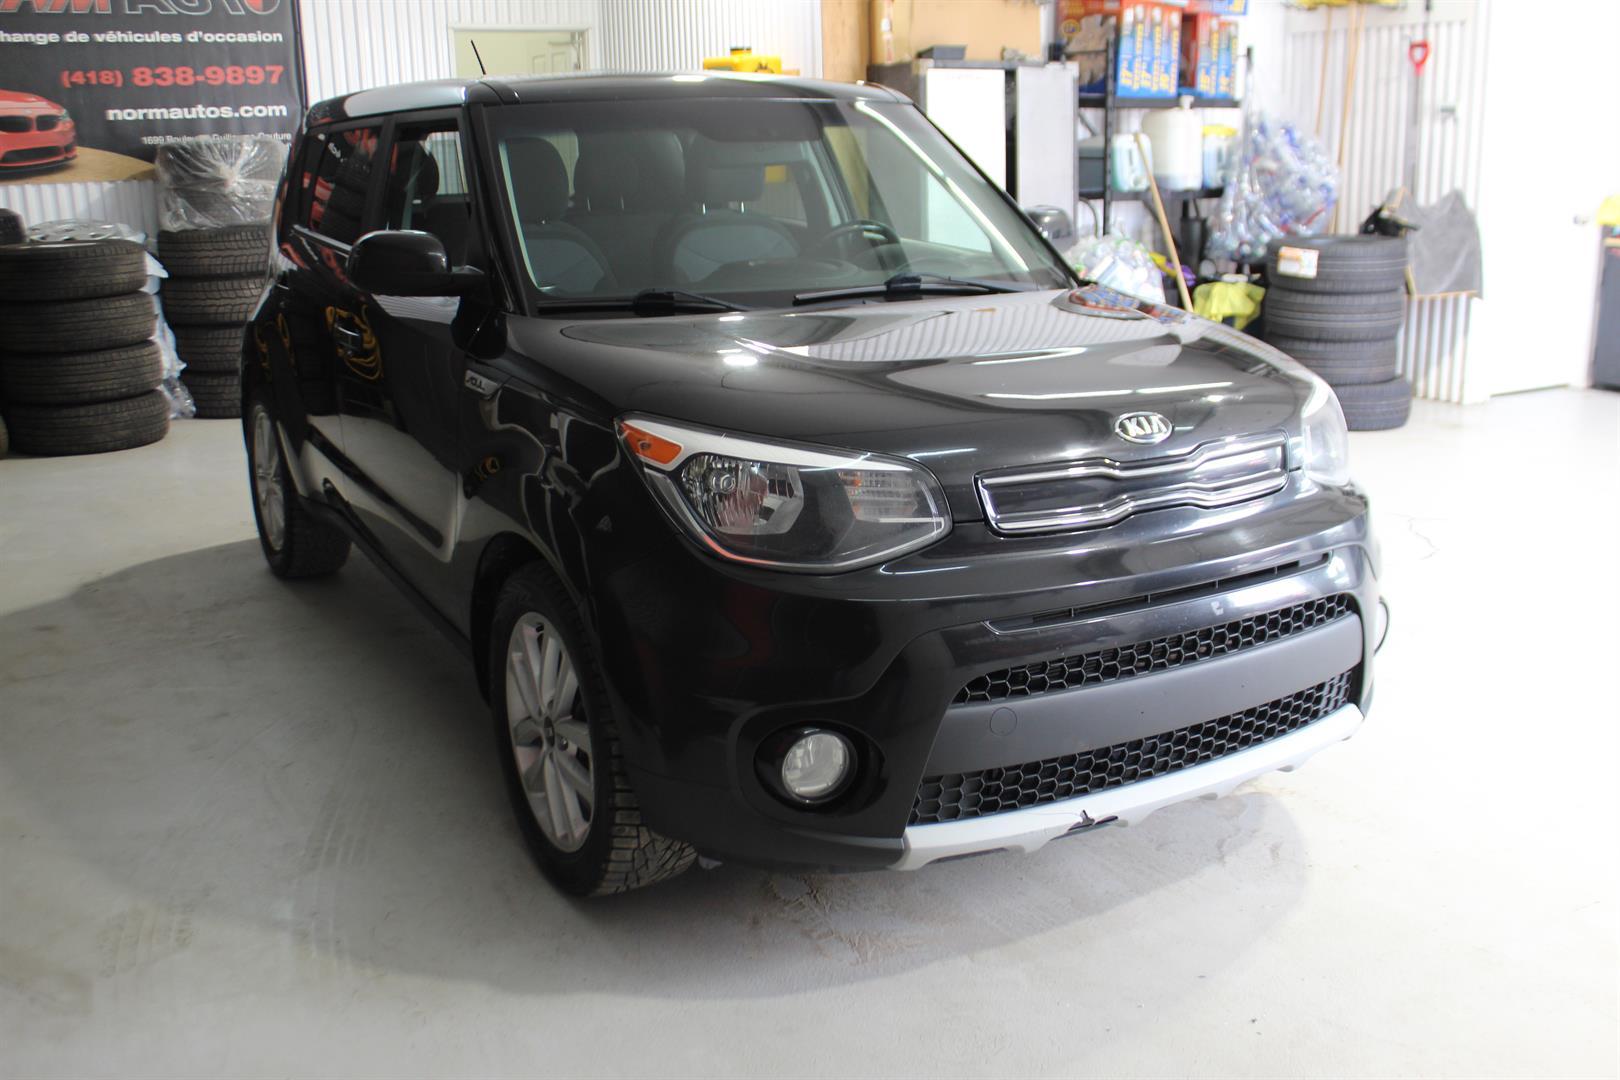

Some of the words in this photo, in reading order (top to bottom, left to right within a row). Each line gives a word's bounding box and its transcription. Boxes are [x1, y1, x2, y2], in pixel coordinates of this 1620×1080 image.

[65, 31, 90, 43] de
[93, 30, 183, 43] véhicules
[186, 30, 283, 42] d'occasion
[62, 70, 124, 88] (418)
[132, 65, 284, 87] 838-9897
[106, 104, 288, 121] normautos.com
[1122, 415, 1168, 437] KIA
